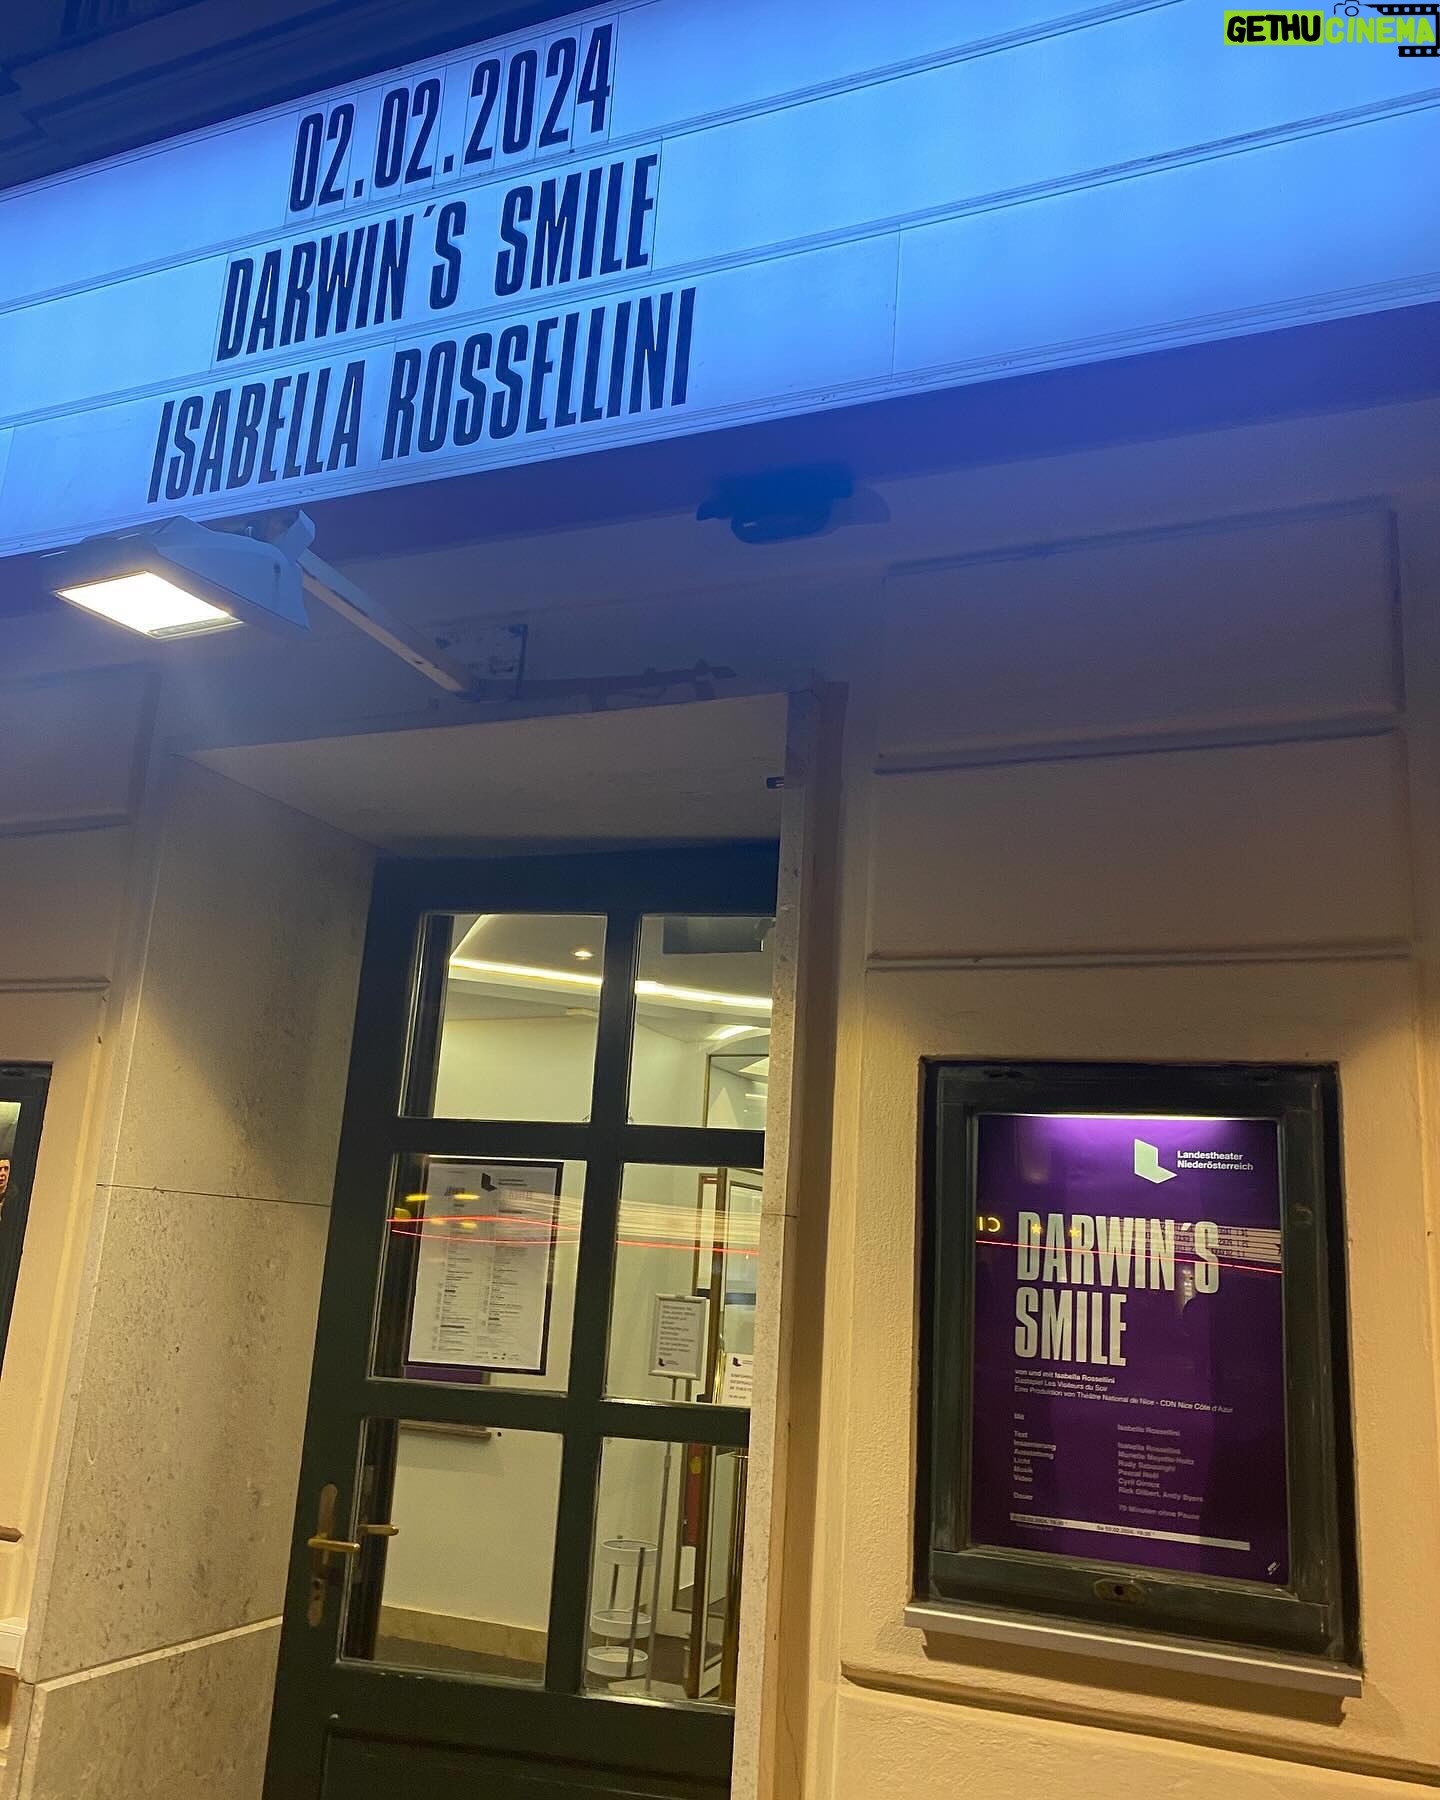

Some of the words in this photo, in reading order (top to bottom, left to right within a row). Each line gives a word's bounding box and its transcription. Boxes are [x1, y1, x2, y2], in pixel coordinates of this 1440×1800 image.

[289, 24, 613, 212] 02.02.2024
[495, 154, 658, 297] SMILE
[147, 360, 365, 504] ISABELLA
[381, 287, 696, 461] ROSSELLINI
[1177, 1150, 1244, 1160] Landestheater
[1177, 1160, 1254, 1171] Niederösterreich
[1014, 1286, 1128, 1367] SMILE
[1028, 1369, 1041, 1377] und
[1054, 1371, 1080, 1381] Isabella
[1081, 1374, 1115, 1384] Rossellini
[1159, 1399, 1176, 1408] CDN
